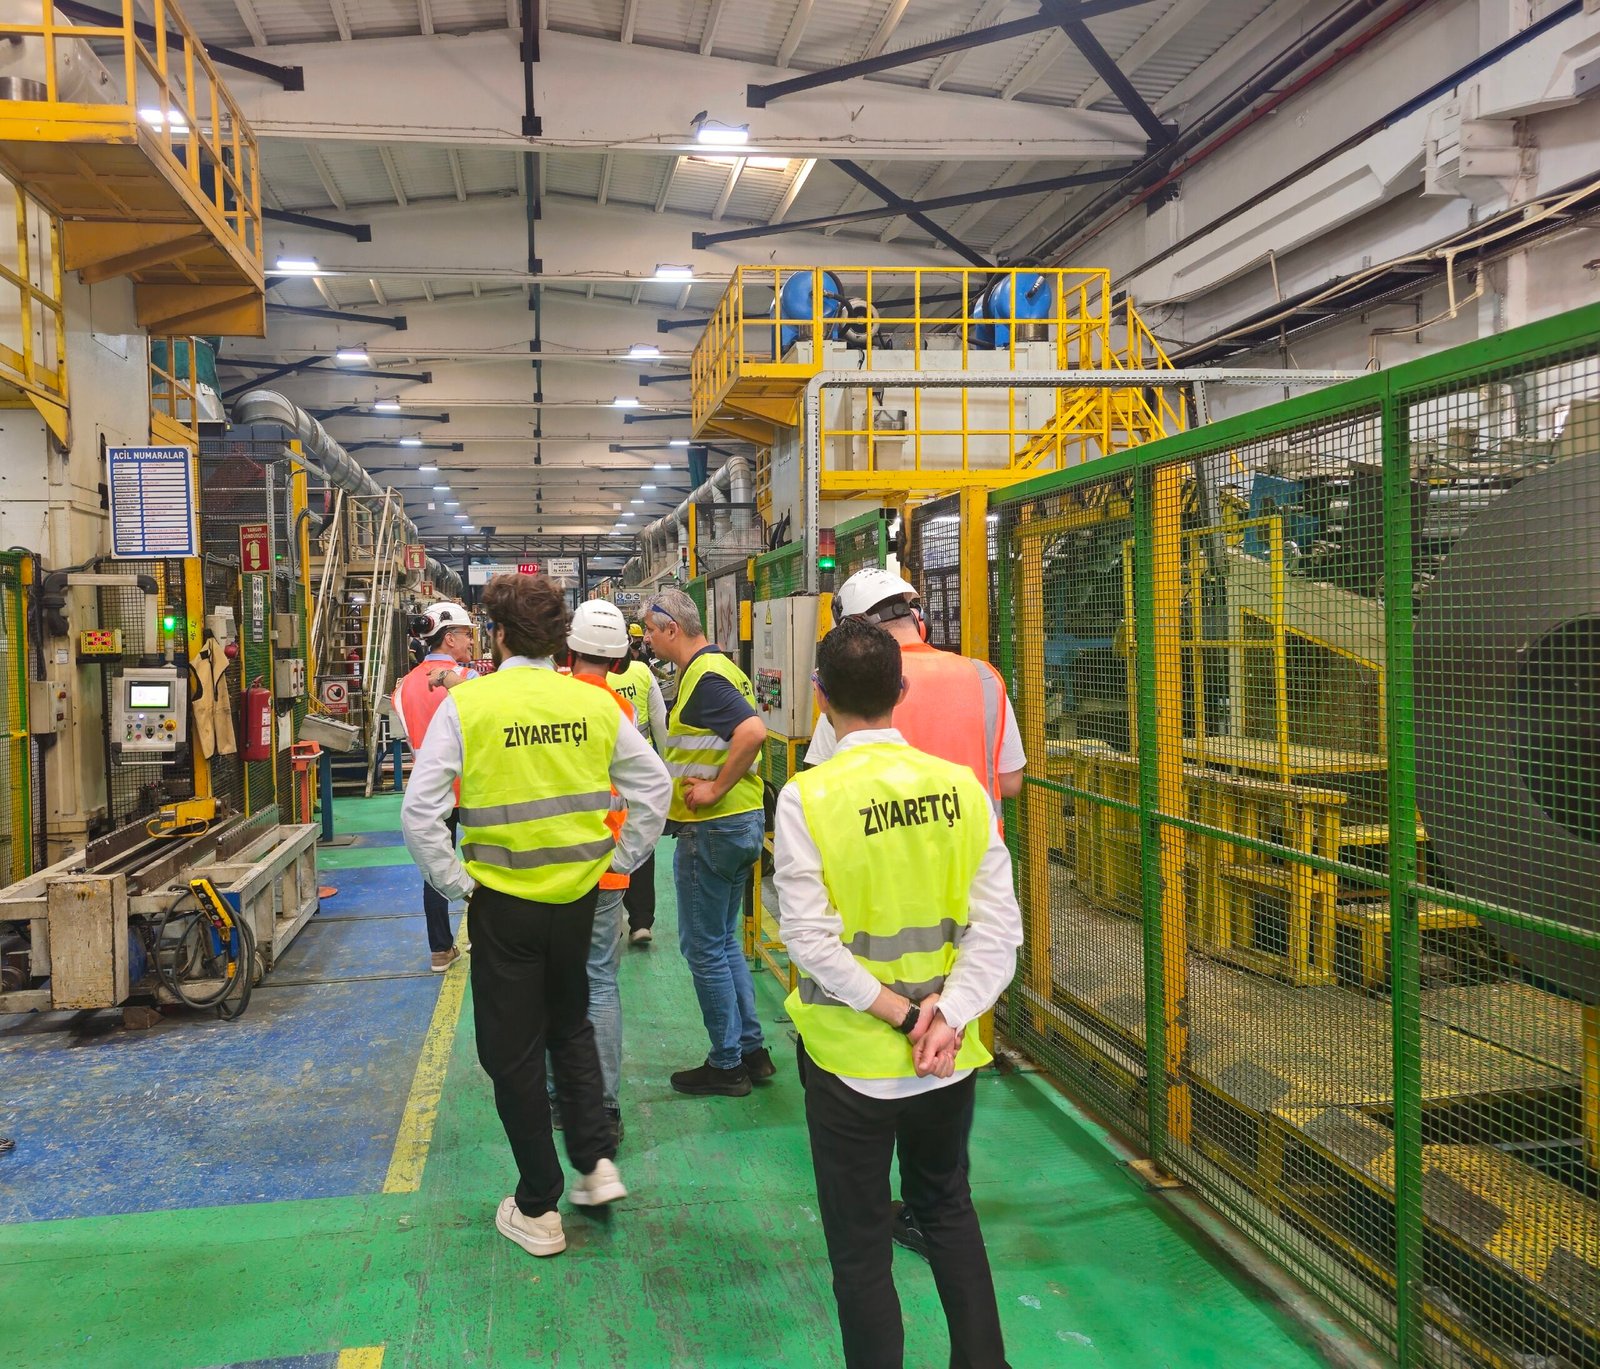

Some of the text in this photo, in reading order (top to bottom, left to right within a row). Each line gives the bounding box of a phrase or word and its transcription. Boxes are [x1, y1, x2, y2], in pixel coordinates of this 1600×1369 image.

[113, 450, 185, 460] ACİL NUMARALAR
[504, 717, 588, 748] ZİYARETÇİ
[859, 786, 961, 836] ZİYARETÇİ
